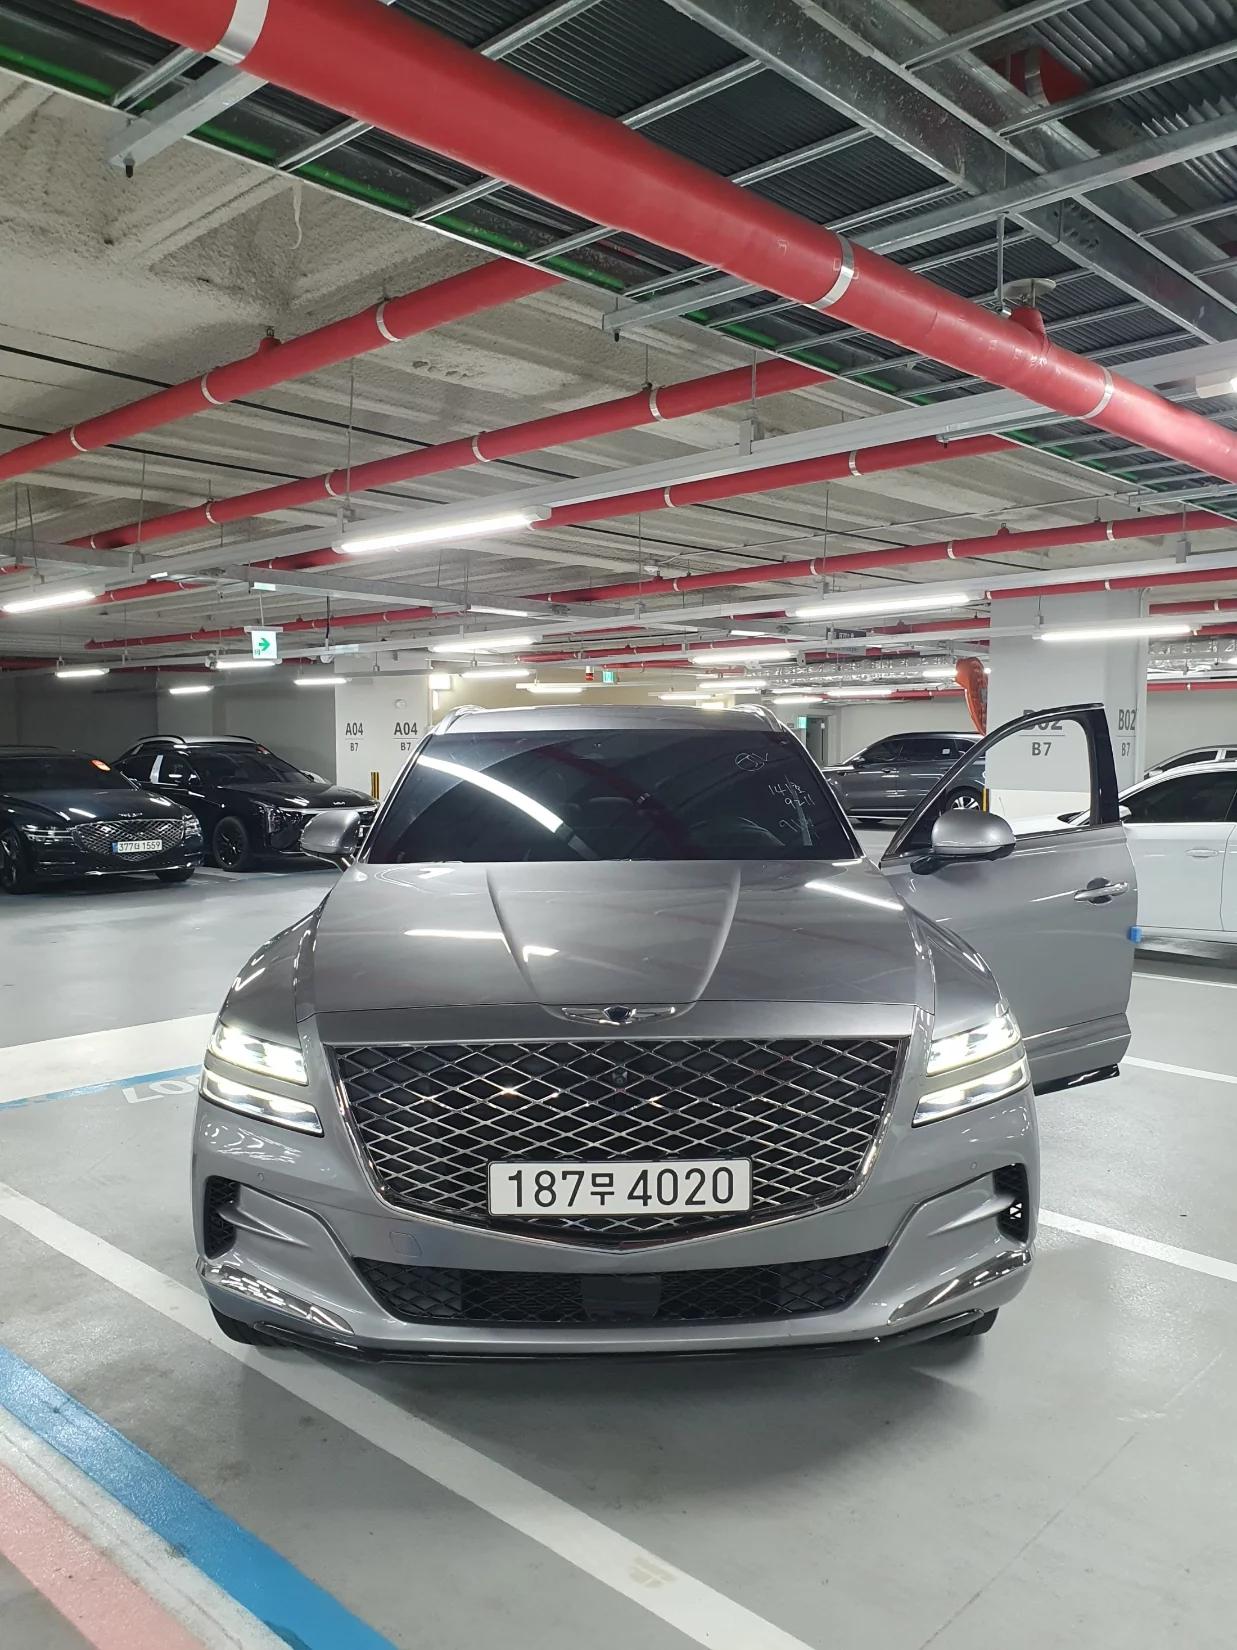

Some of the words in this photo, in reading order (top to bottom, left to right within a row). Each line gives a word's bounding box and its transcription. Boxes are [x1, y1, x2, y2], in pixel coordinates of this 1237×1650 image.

[1118, 709, 1136, 731] B02
[345, 722, 363, 736] A04
[393, 722, 418, 736] A04
[350, 742, 359, 752] B7
[400, 742, 412, 751] B7
[1032, 742, 1052, 756] B7
[1121, 743, 1131, 756] B7
[142, 841, 161, 850] 1559
[507, 1169, 615, 1208] 187무
[627, 1166, 734, 1207] 4020
